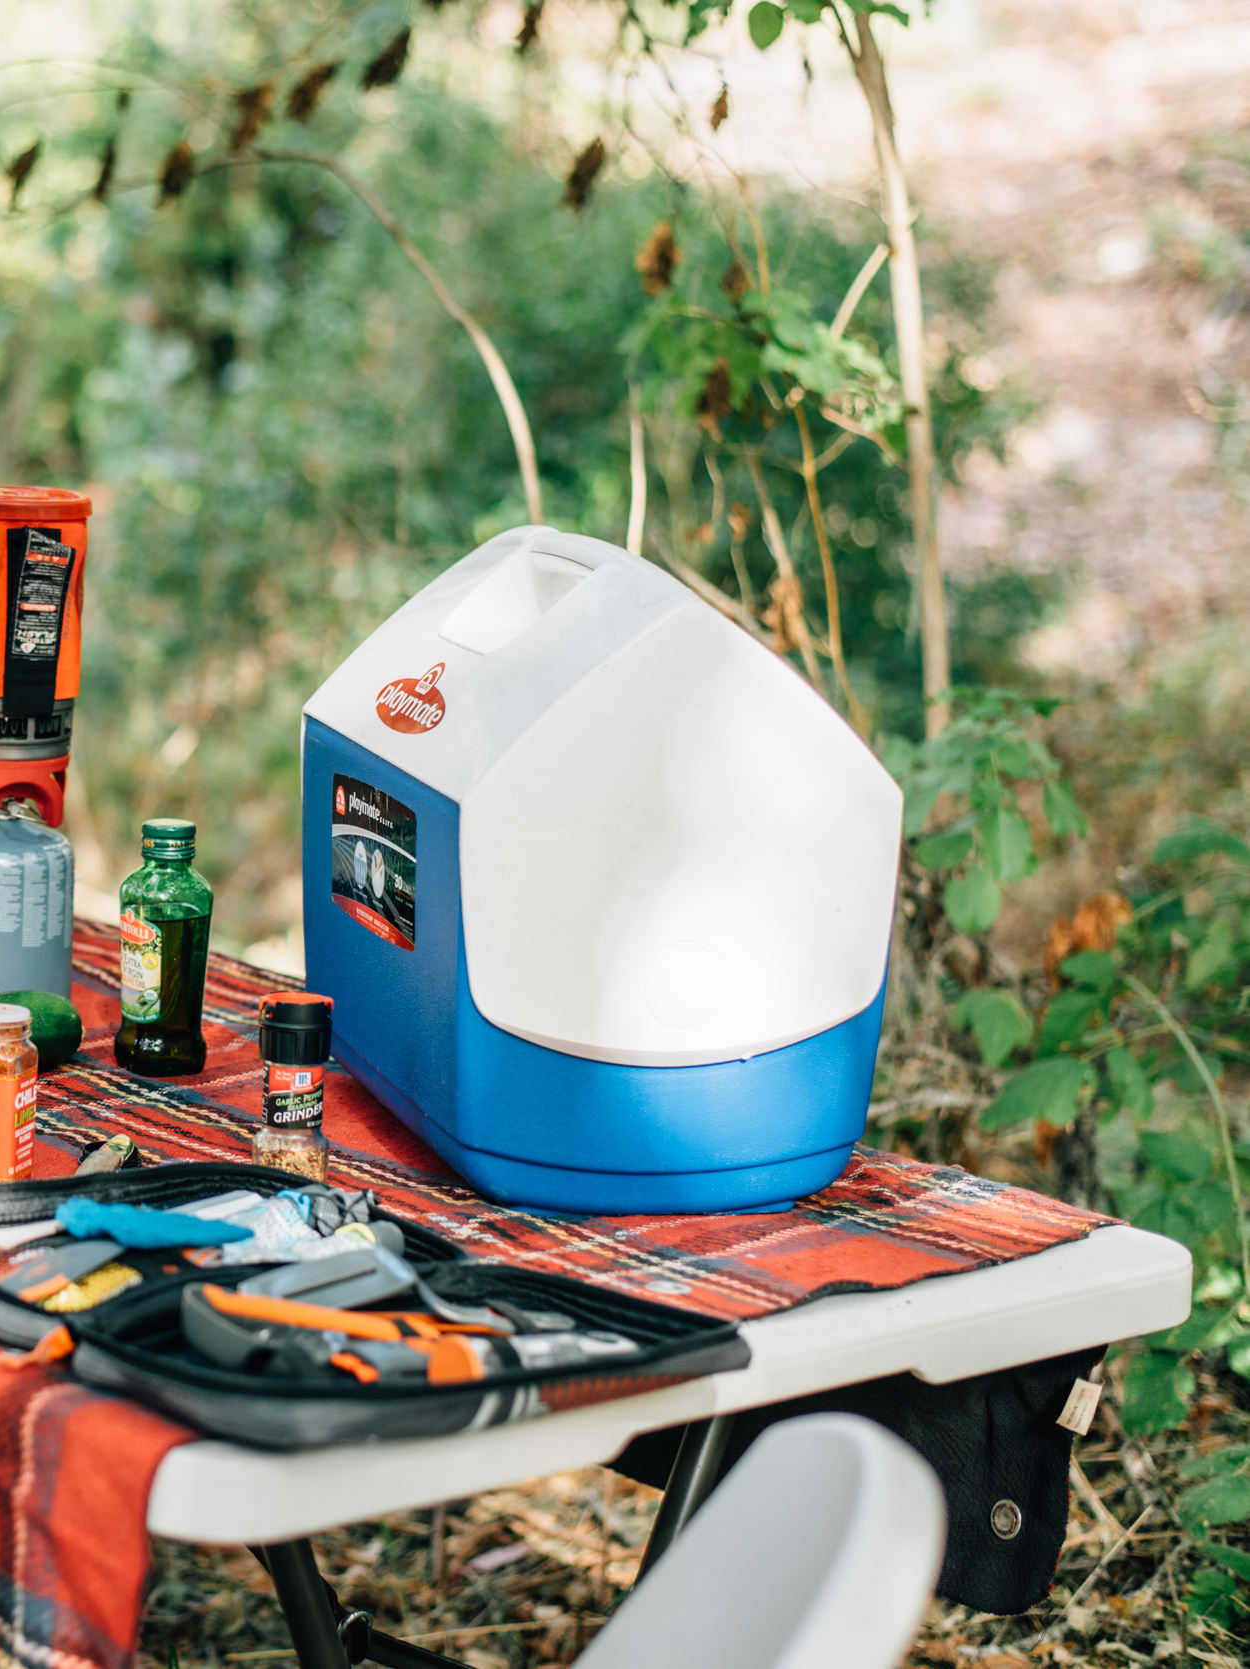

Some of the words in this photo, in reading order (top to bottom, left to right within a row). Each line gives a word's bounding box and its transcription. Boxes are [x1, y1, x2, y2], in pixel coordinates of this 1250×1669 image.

[376, 682, 443, 728] playmate
[349, 791, 380, 820] playmate
[120, 921, 149, 939] ERTOLLI
[273, 1101, 322, 1123] GRINDER
[275, 1097, 302, 1106] GARLIC
[15, 1105, 34, 1128] LIME
